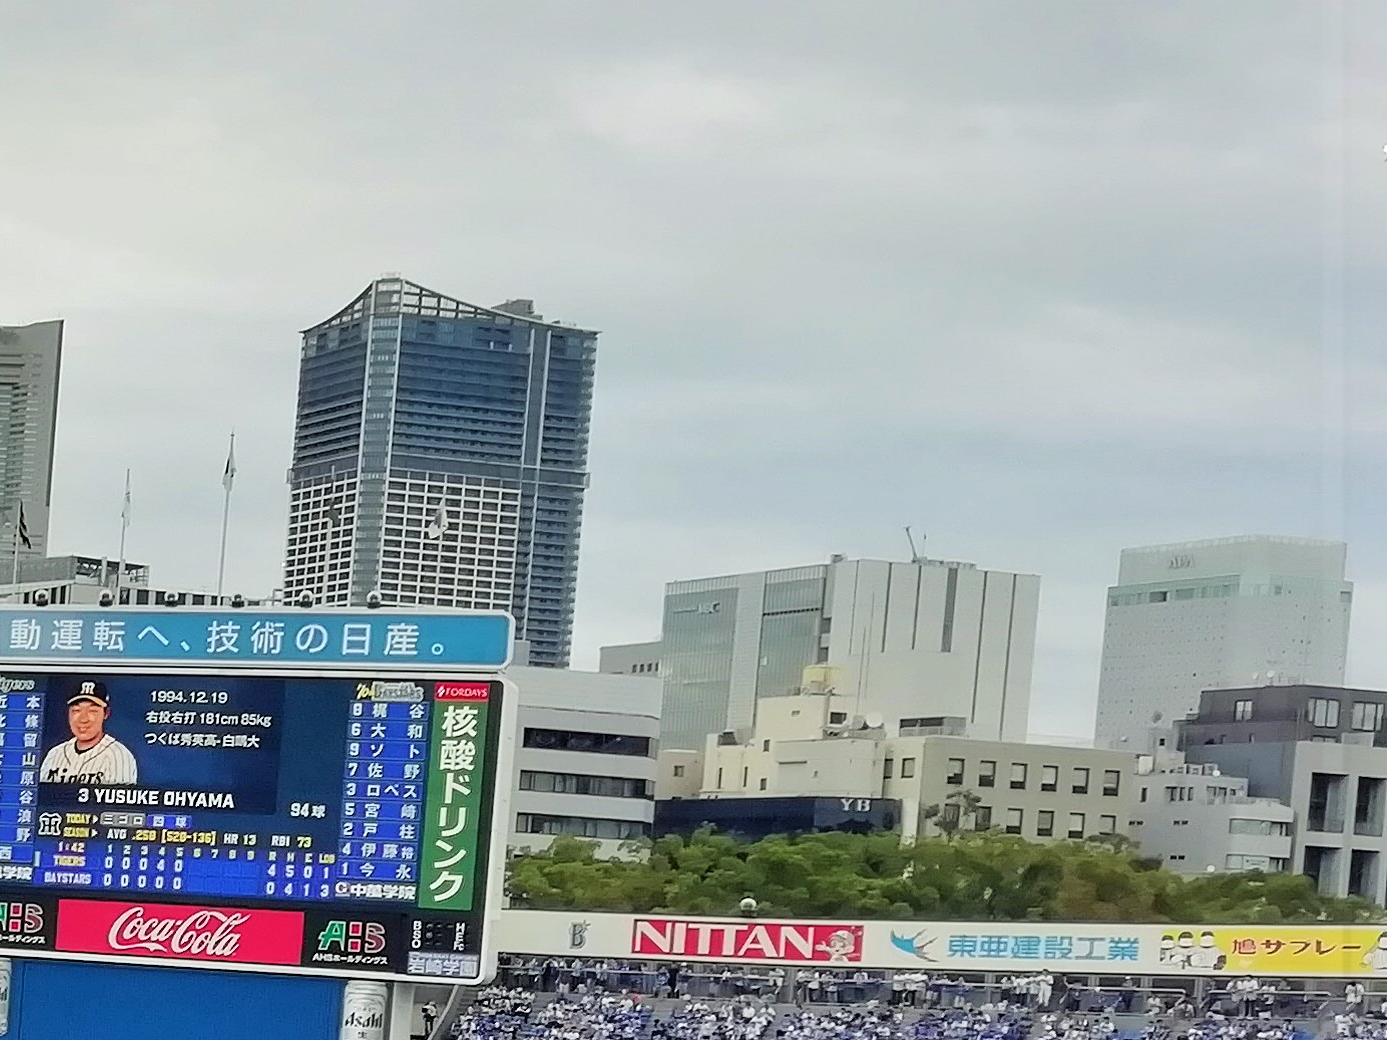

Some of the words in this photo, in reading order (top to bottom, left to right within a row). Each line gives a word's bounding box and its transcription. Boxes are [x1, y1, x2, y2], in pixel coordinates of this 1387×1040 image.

[151, 690, 228, 705] 1994.12.19
[445, 687, 488, 698] FORDAYS
[353, 704, 362, 716] 8
[199, 713, 239, 726] 181cm
[240, 714, 272, 728] 85kg
[351, 724, 361, 735] 6
[349, 743, 360, 756] 9
[348, 763, 358, 776] 7
[346, 783, 356, 795] 3
[78, 789, 89, 802] 3
[94, 789, 159, 805] YUSUKE
[163, 792, 235, 809] OHYAMA
[430, 705, 478, 902] 核酸ドリンク
[345, 803, 355, 815] 5
[343, 823, 353, 835] 2
[224, 833, 239, 844] HR
[243, 834, 257, 846] 13
[271, 835, 290, 847] RBI
[297, 836, 312, 848] 73
[58, 842, 85, 853] 1:42
[342, 843, 351, 855] 4
[104, 857, 113, 869] 0
[122, 857, 131, 870] 0
[139, 858, 148, 871] 0
[156, 859, 165, 871] 4
[174, 859, 183, 872] 0
[268, 863, 276, 877] 4
[285, 865, 295, 877] 5
[303, 865, 312, 879] 0
[323, 867, 329, 879] 1
[342, 863, 348, 874] 1
[103, 874, 111, 886] 0
[120, 875, 129, 887] 0
[137, 876, 146, 888] 0
[155, 876, 164, 889] 0
[172, 877, 181, 889] 0
[266, 882, 275, 894] 0
[284, 883, 293, 895] 4
[303, 884, 310, 896] 1
[320, 885, 329, 897] 3
[108, 906, 251, 957] Coca-Cola
[413, 920, 422, 930] B
[413, 930, 422, 940] S
[634, 921, 816, 959] NITTAN
[949, 934, 1139, 962] 東亜建設工業
[345, 1012, 383, 1030] Asahi
